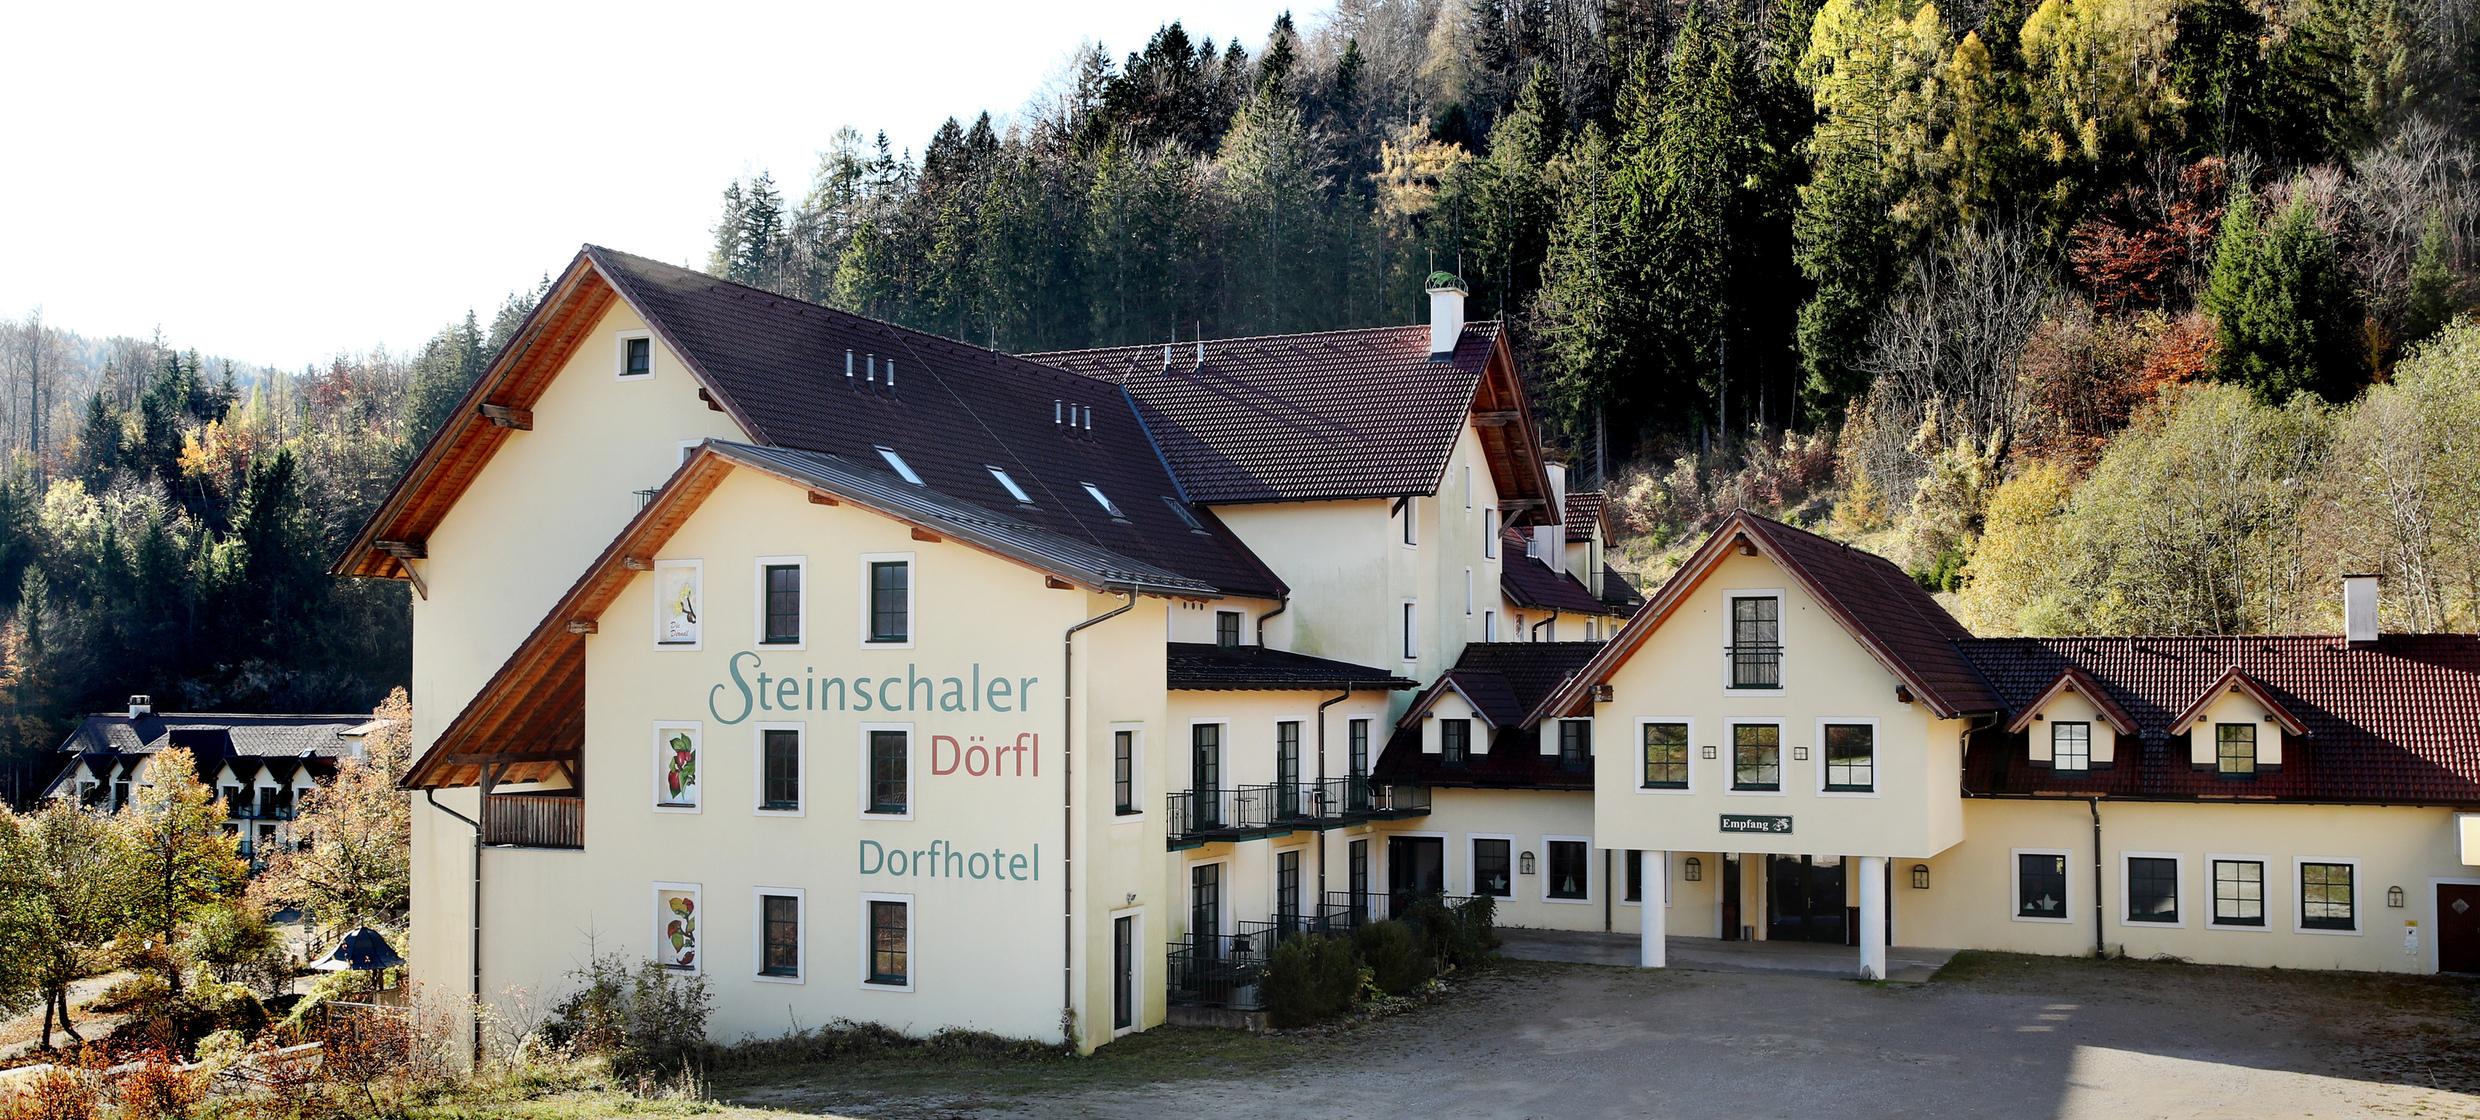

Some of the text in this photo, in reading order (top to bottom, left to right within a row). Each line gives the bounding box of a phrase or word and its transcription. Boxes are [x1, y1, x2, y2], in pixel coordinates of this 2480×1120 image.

[709, 651, 1038, 725] Steinschaler
[931, 732, 1039, 777] Dörfl
[1723, 818, 1769, 831] Empfang
[859, 840, 1039, 881] Dorfhotel
